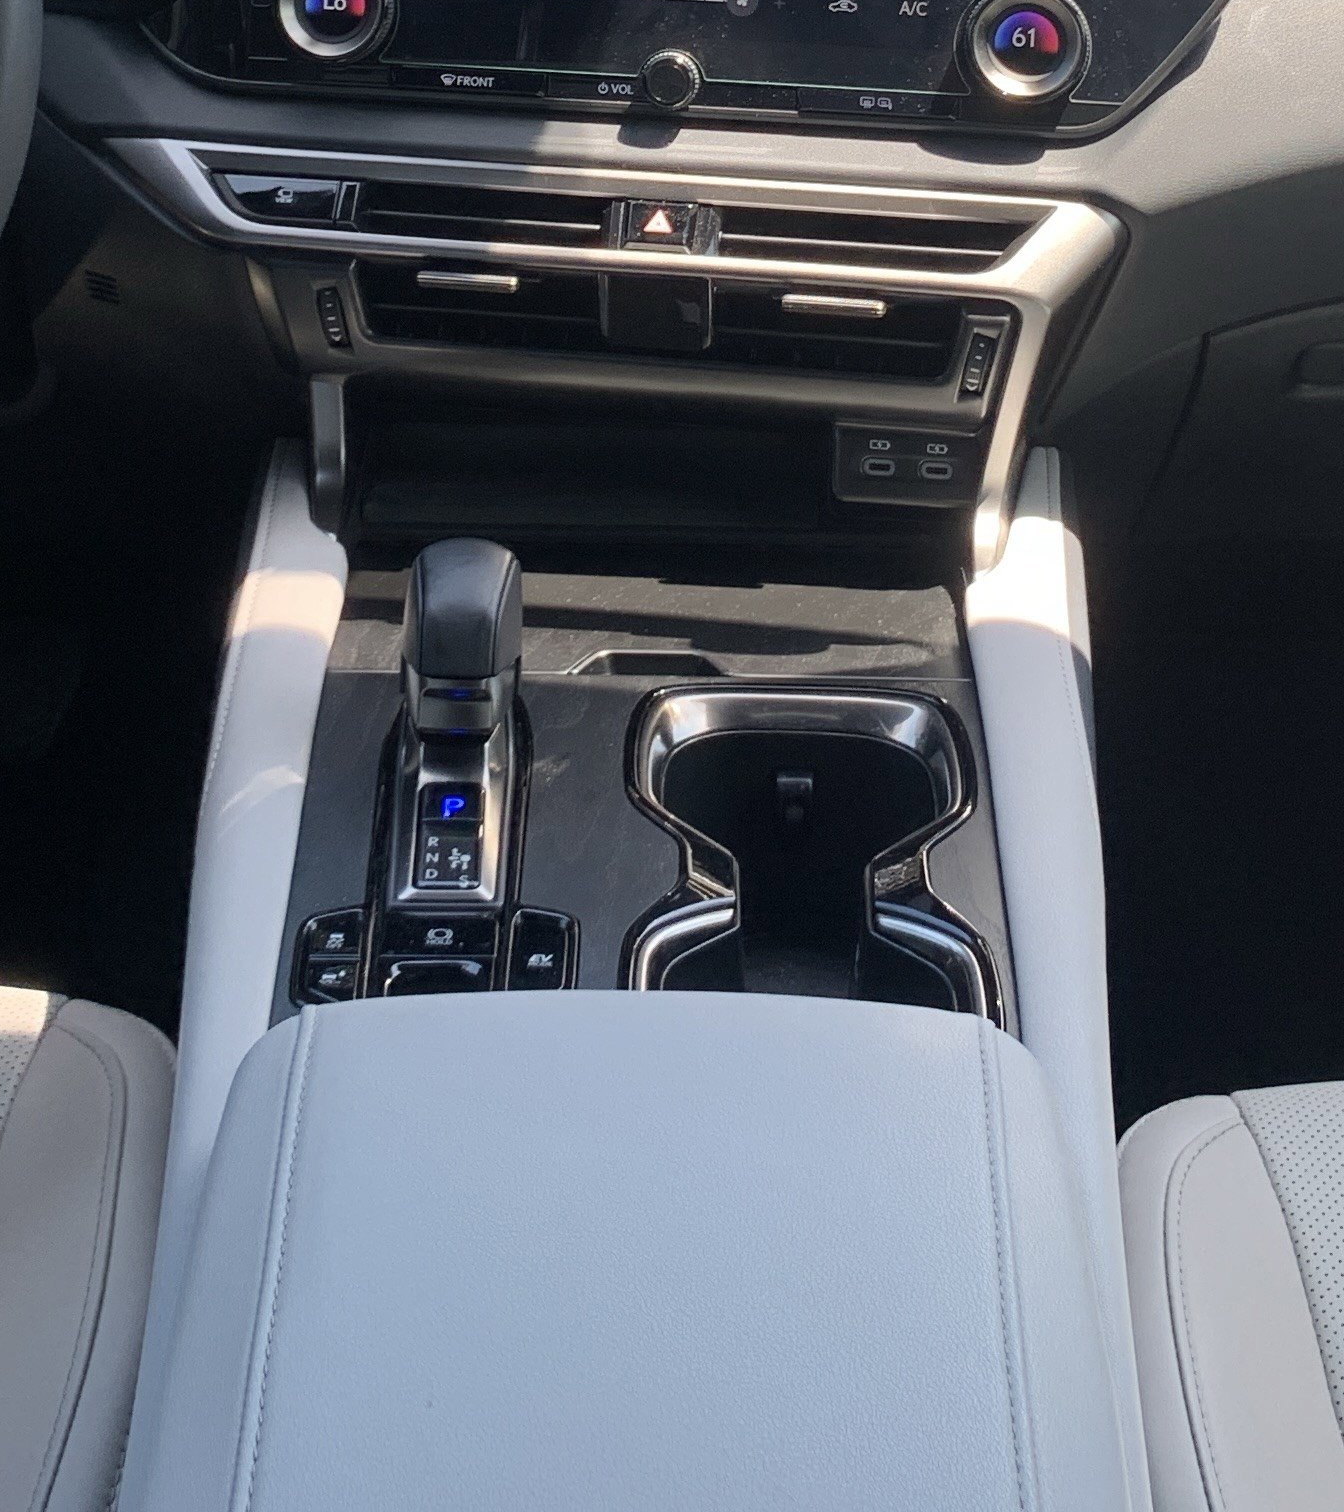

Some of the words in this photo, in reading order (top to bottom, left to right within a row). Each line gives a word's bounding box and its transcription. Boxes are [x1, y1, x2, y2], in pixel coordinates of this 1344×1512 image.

[898, 0, 929, 17] A/C
[1011, 27, 1037, 49] 61
[456, 74, 495, 88] FRONT
[610, 83, 635, 96] VOL
[443, 798, 465, 818] P
[427, 836, 439, 847] R
[425, 852, 439, 863] N
[425, 868, 439, 879] D
